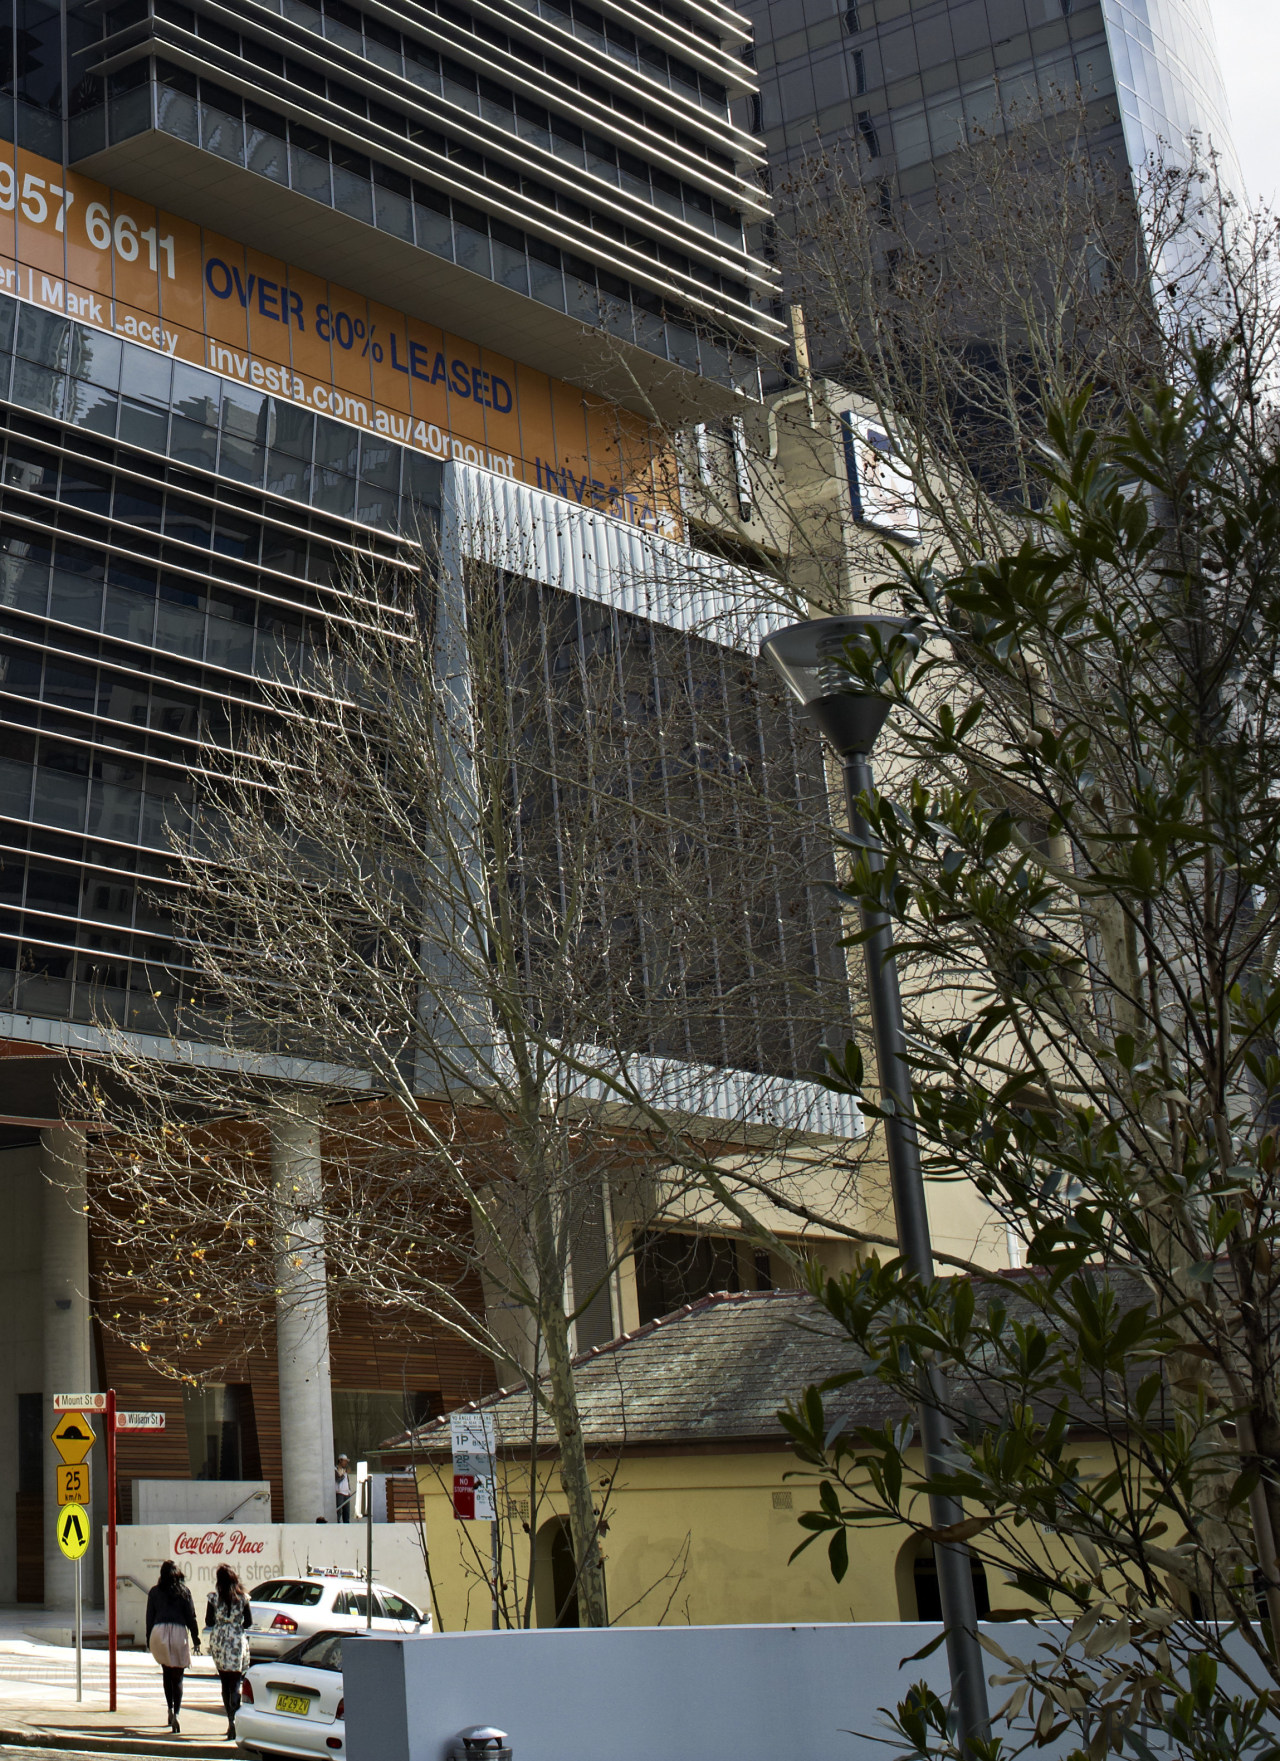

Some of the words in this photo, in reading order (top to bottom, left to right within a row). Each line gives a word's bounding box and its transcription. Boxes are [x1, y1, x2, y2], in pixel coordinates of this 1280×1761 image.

[85, 202, 175, 280] 6611
[41, 276, 104, 324] Mark
[110, 303, 179, 355] Lacey
[205, 257, 305, 332] OVER
[315, 303, 384, 364] 80%
[390, 332, 513, 414] LEASED
[210, 338, 515, 478] investa.com.au/40mount
[62, 1395, 83, 1405] Mount
[85, 1394, 93, 1405] St
[128, 1413, 149, 1424] William
[151, 1413, 158, 1422] St
[456, 1435, 468, 1446] 1P
[455, 1454, 469, 1464] 2P
[66, 1471, 81, 1491] 25
[460, 1478, 469, 1486] NO
[65, 1492, 81, 1501] km/h
[174, 1530, 226, 1556] Coca-Cola
[225, 1530, 264, 1555] Place
